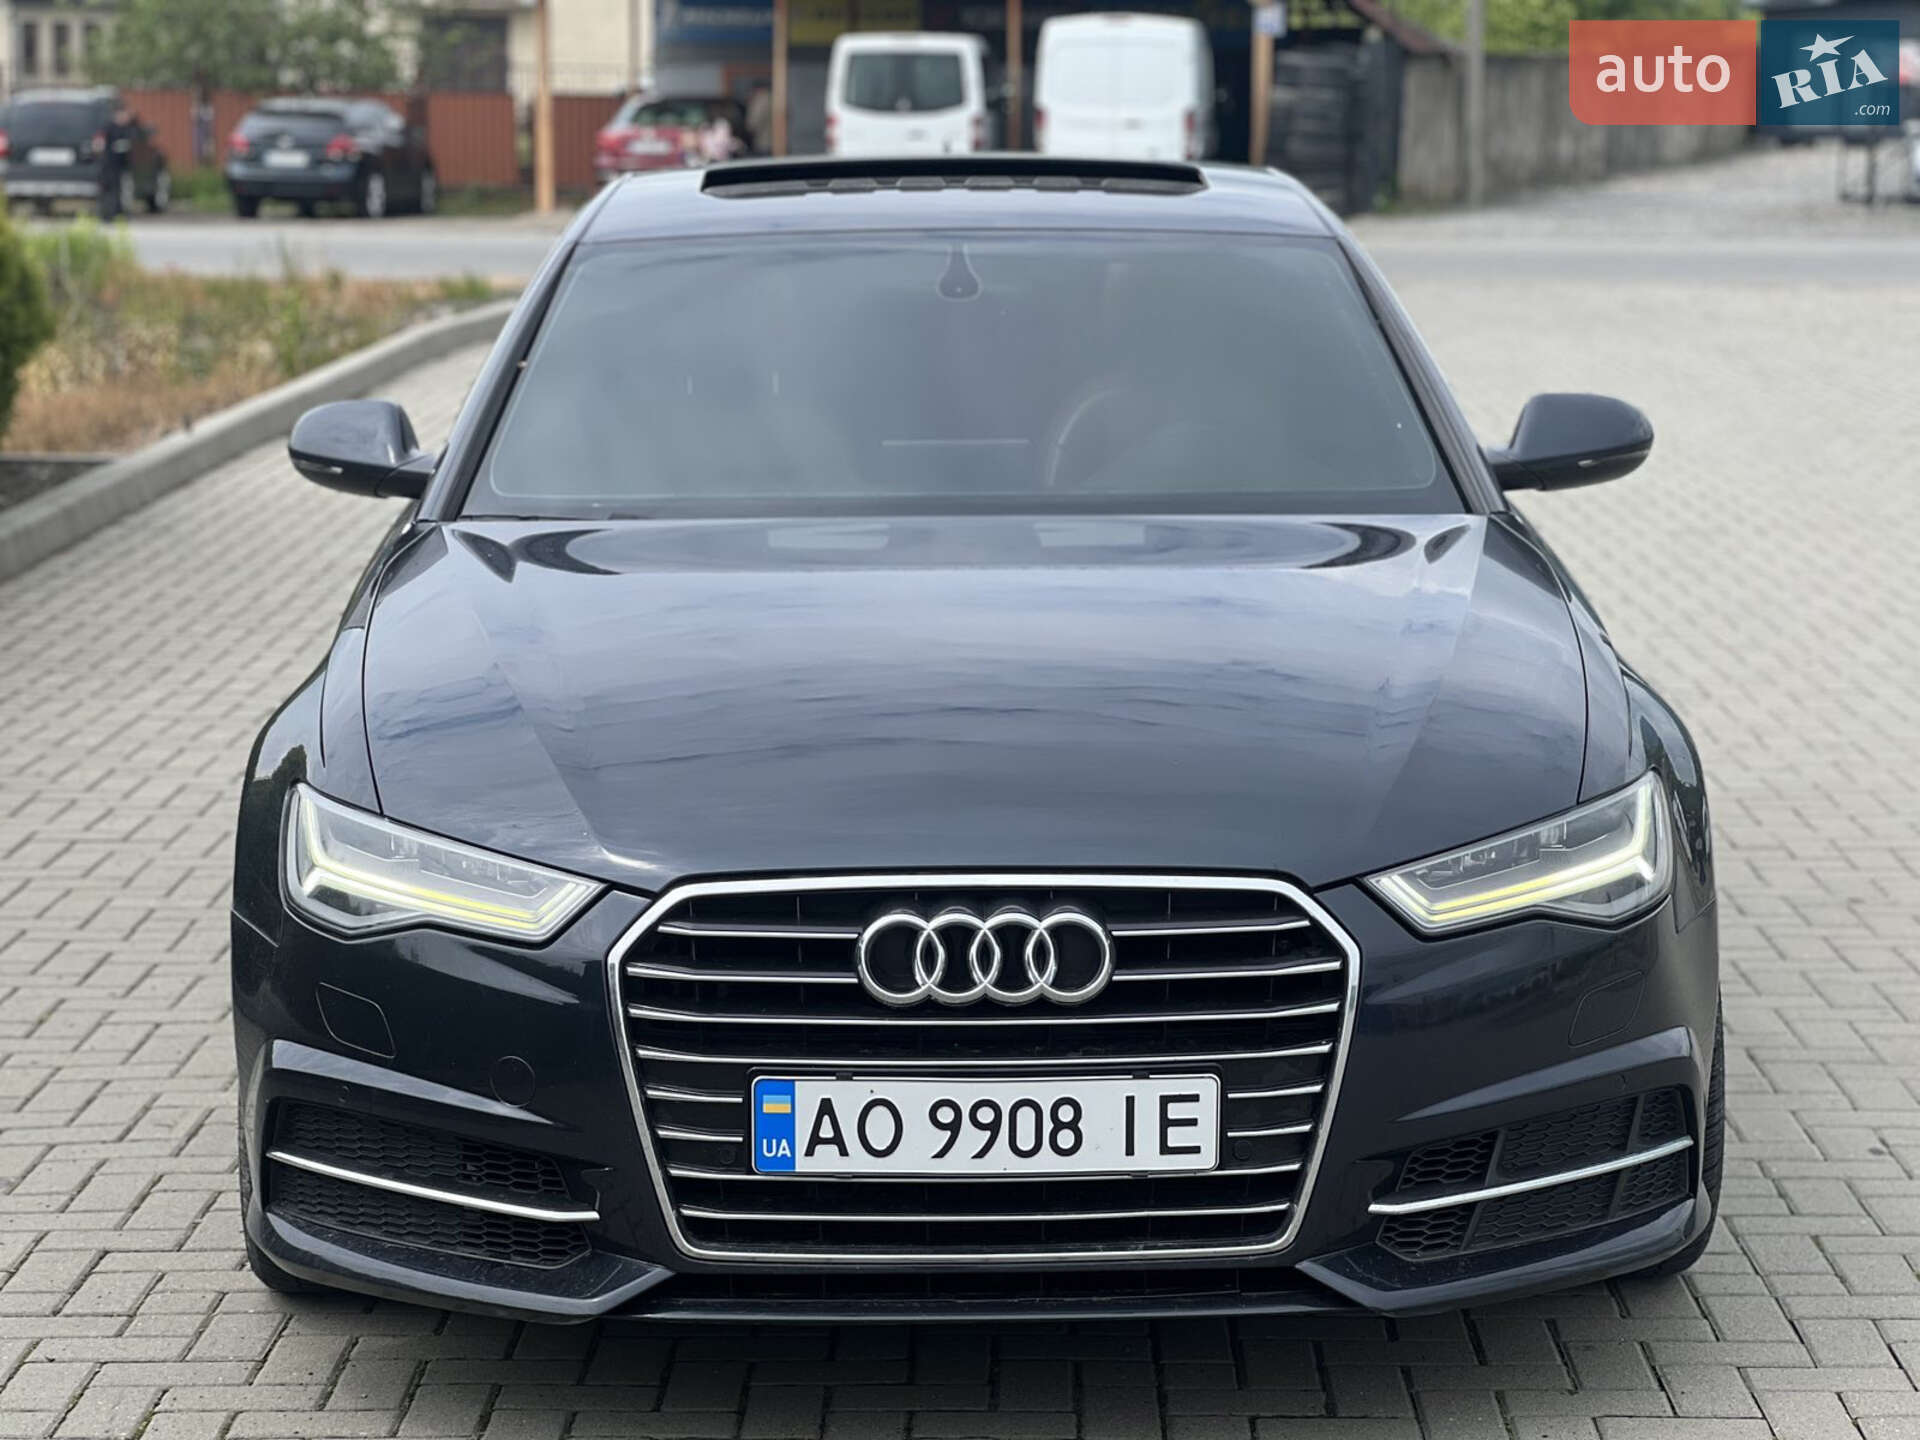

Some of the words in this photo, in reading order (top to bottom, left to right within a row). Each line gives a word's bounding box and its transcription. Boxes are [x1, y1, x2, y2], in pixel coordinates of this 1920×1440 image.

[762, 1140, 791, 1158] UA
[803, 1096, 904, 1159] AO
[928, 1095, 1084, 1160] 9908
[1124, 1092, 1202, 1157] IE
